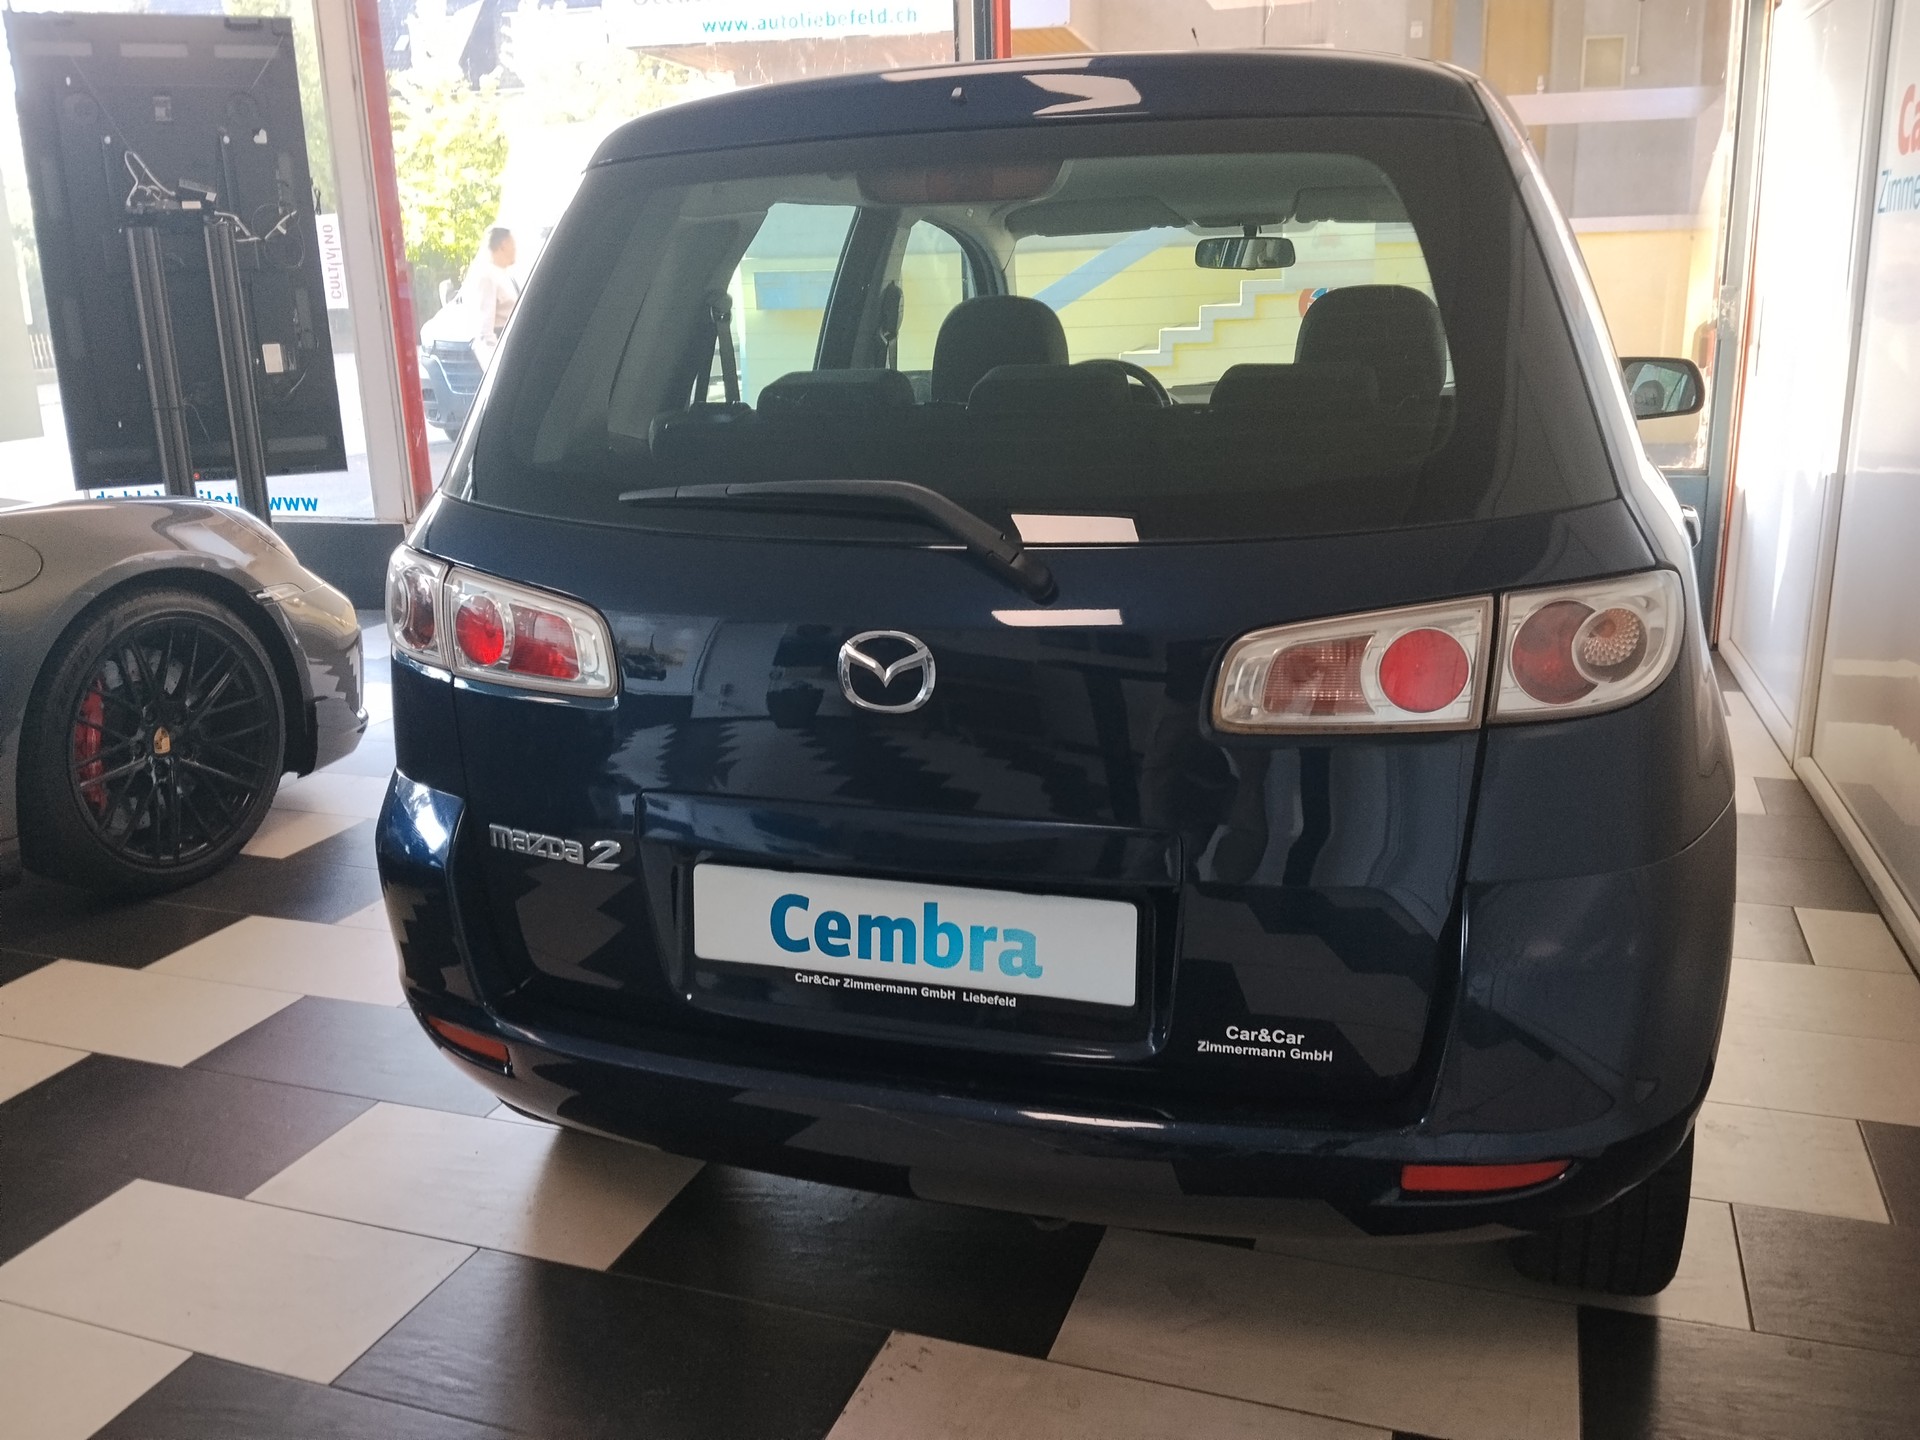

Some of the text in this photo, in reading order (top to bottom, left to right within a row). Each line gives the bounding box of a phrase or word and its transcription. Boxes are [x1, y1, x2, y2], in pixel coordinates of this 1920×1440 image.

[702, 7, 917, 33] www.autoliebefeld.ch
[586, 840, 622, 871] 2
[770, 893, 1044, 980] Cembra
[795, 972, 1017, 1008] Car&Car Zimmermann GmbH Liebefeld
[1225, 1025, 1305, 1046] Car&Car
[1197, 1040, 1333, 1063] Zimmermann GmbH
